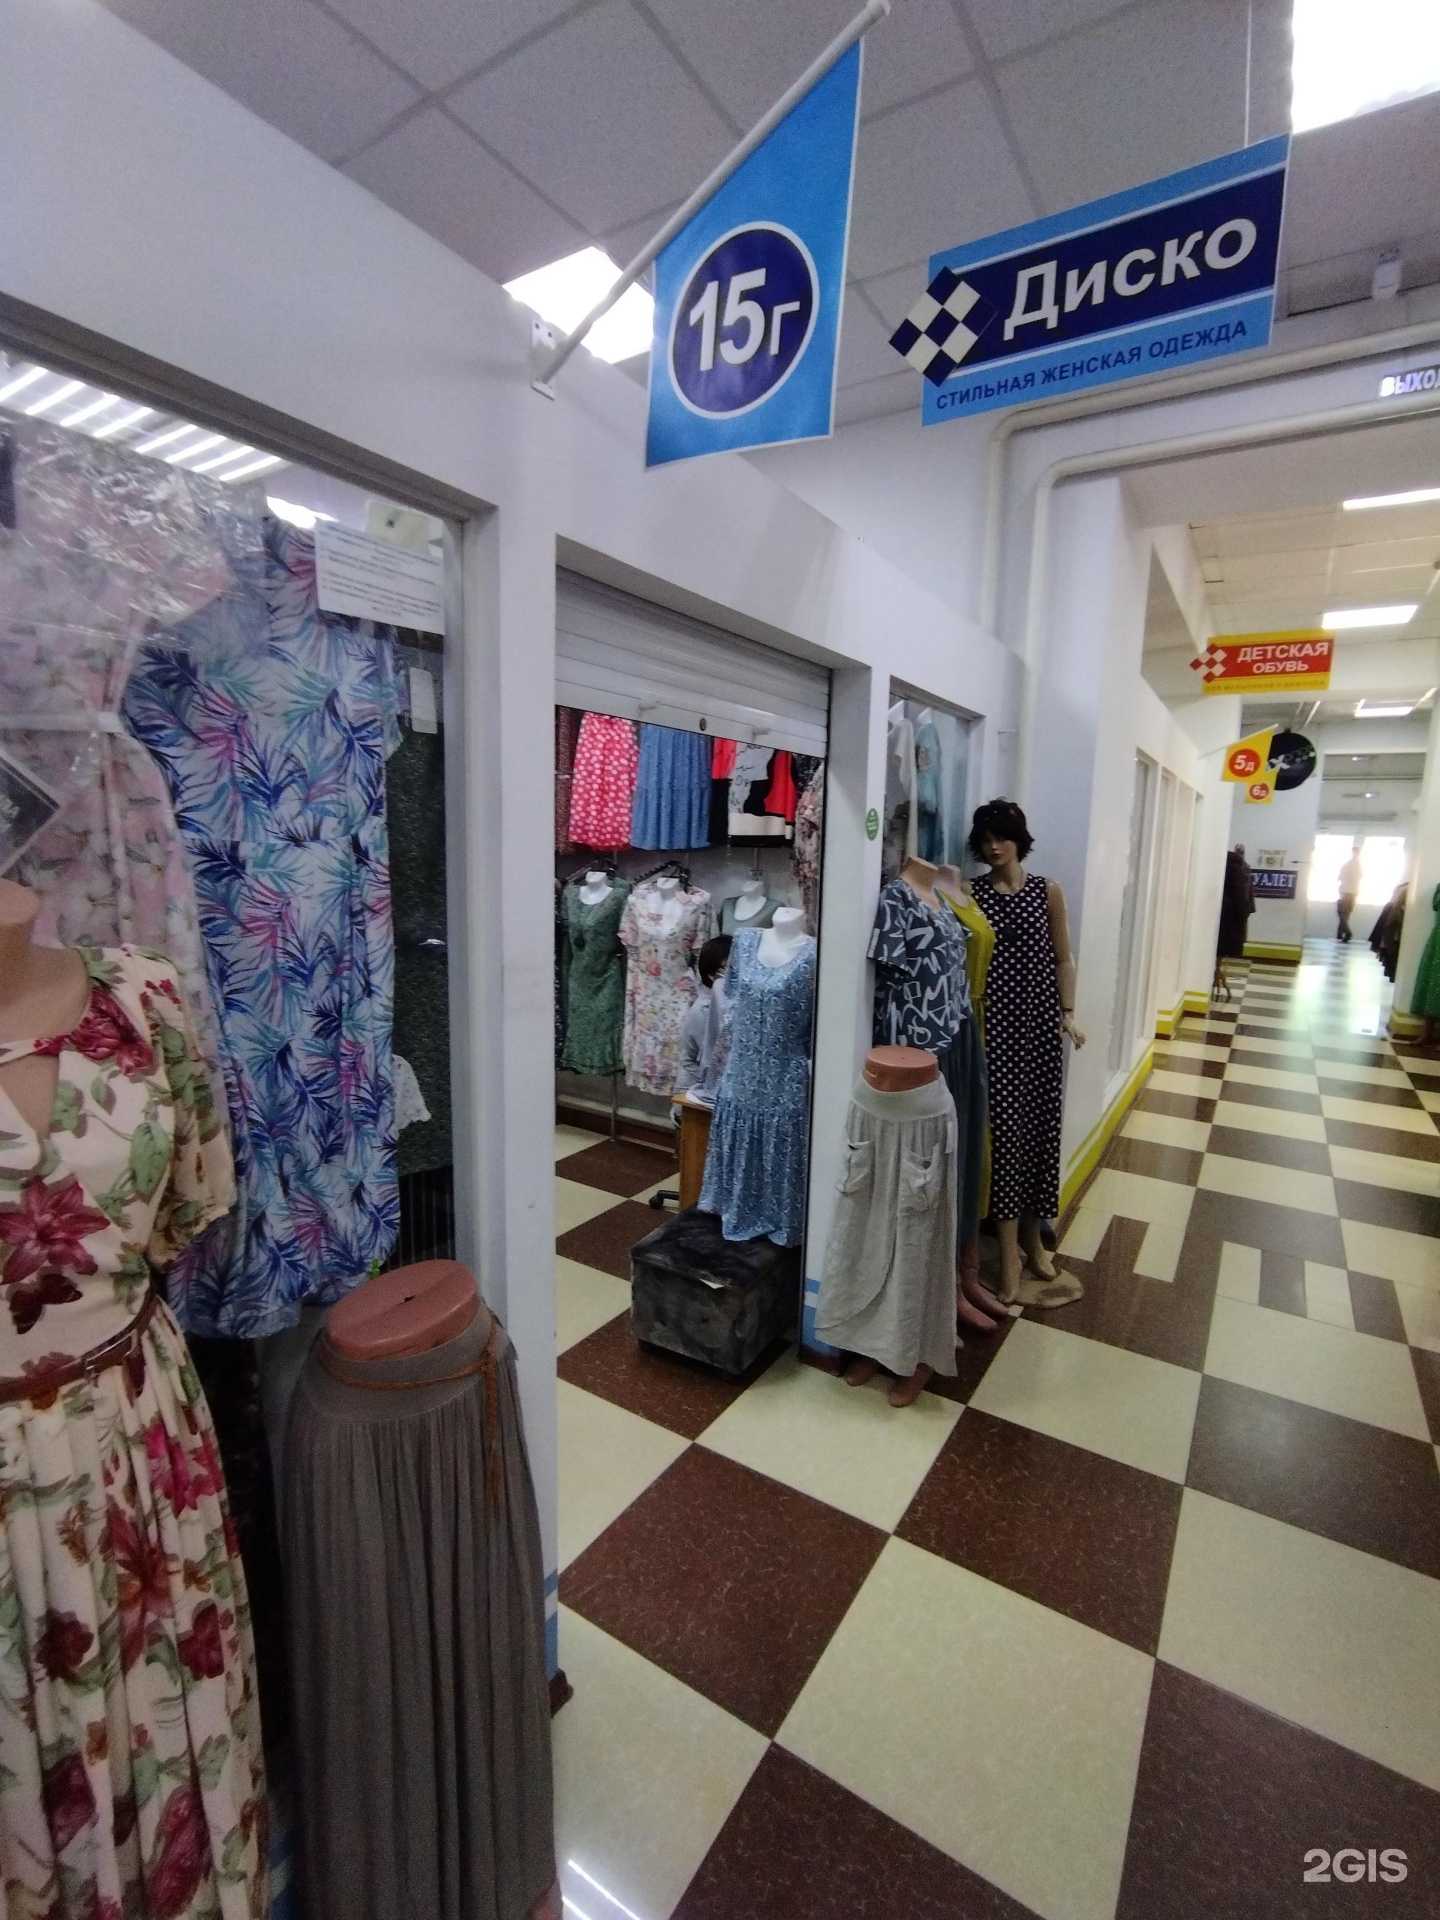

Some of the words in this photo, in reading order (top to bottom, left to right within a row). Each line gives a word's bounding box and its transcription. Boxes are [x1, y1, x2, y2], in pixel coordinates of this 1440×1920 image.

[1003, 218, 1257, 341] Диско
[936, 372, 1036, 410] СТИЛЬНАЯ
[1041, 348, 1141, 385] ЖЕНСКАЯ
[1149, 320, 1247, 358] ОДЕЖДА
[1237, 642, 1329, 663] ДЕТСКАЯ
[1253, 660, 1309, 674] ОБУВЬ
[1250, 872, 1296, 888] УАЛЕТ
